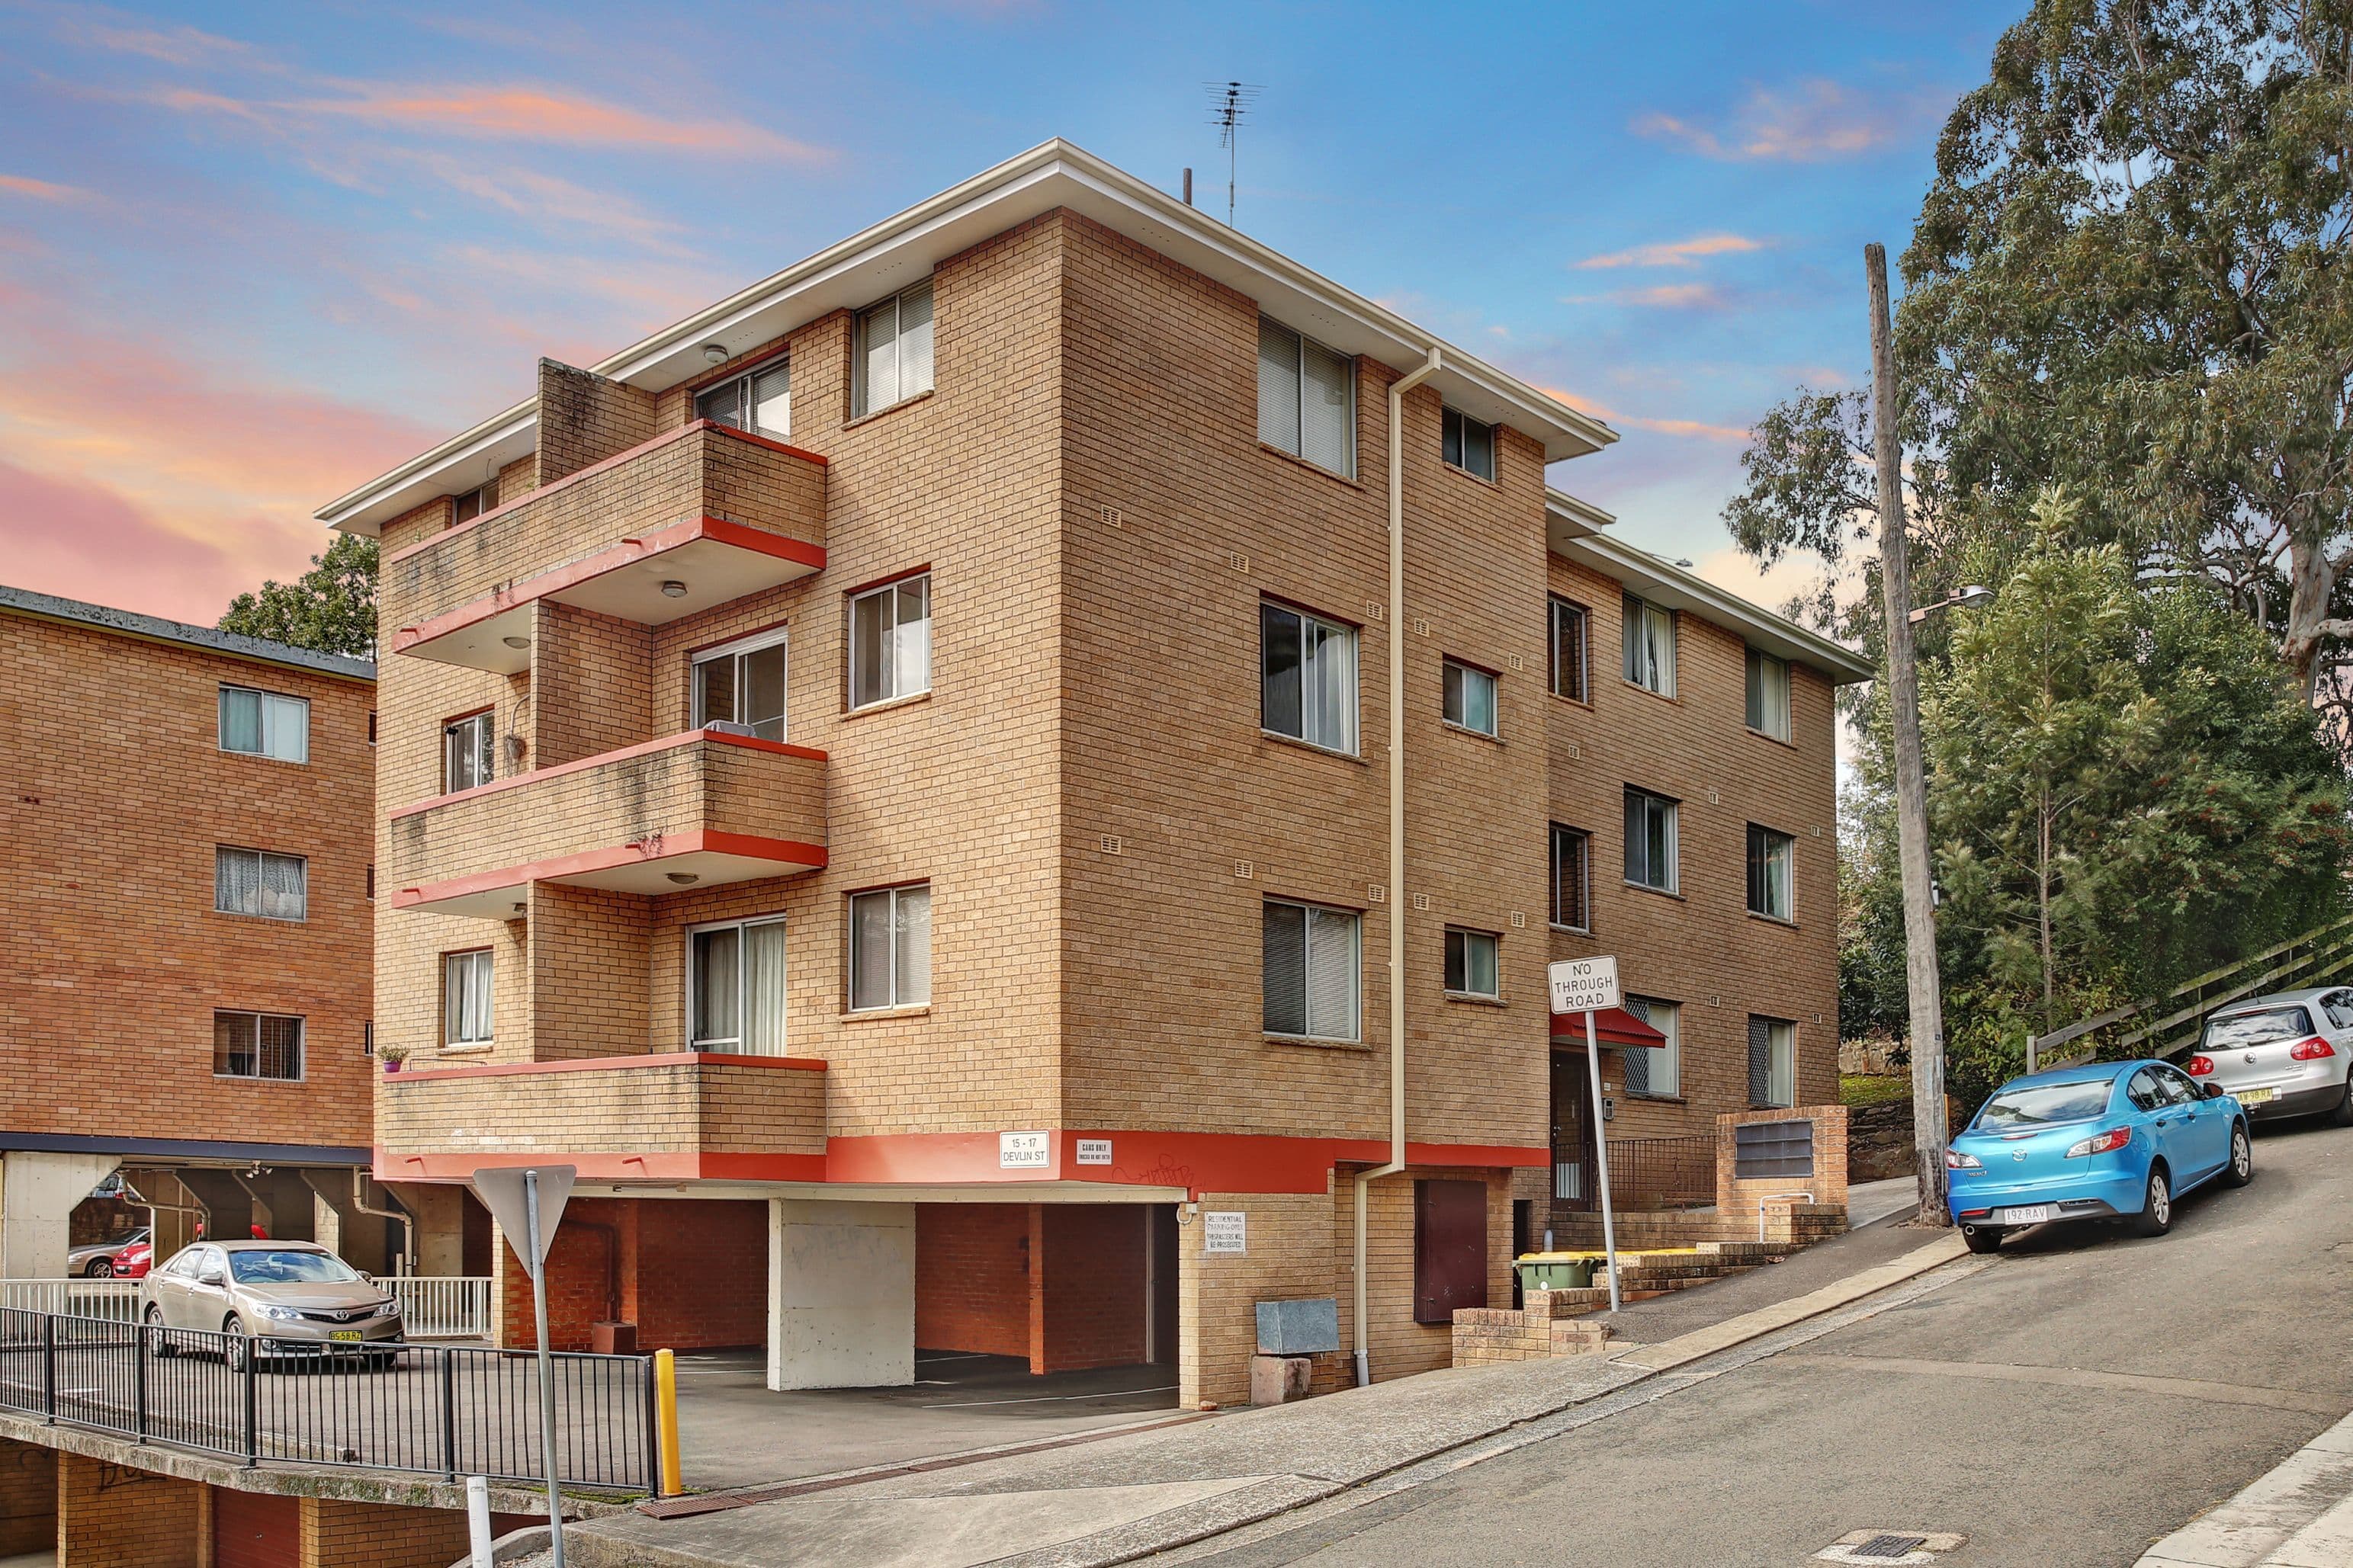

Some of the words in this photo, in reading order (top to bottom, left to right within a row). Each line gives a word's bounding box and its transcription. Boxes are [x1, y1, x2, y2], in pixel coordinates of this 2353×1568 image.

[1573, 963, 1591, 976] NO
[1555, 976, 1613, 993] THROUGH
[1566, 993, 1604, 1007] ROAD
[1013, 1138, 1020, 1147] 15
[1029, 1137, 1037, 1147] 17
[1003, 1151, 1032, 1161] DEVLIN
[1035, 1150, 1045, 1160] ST
